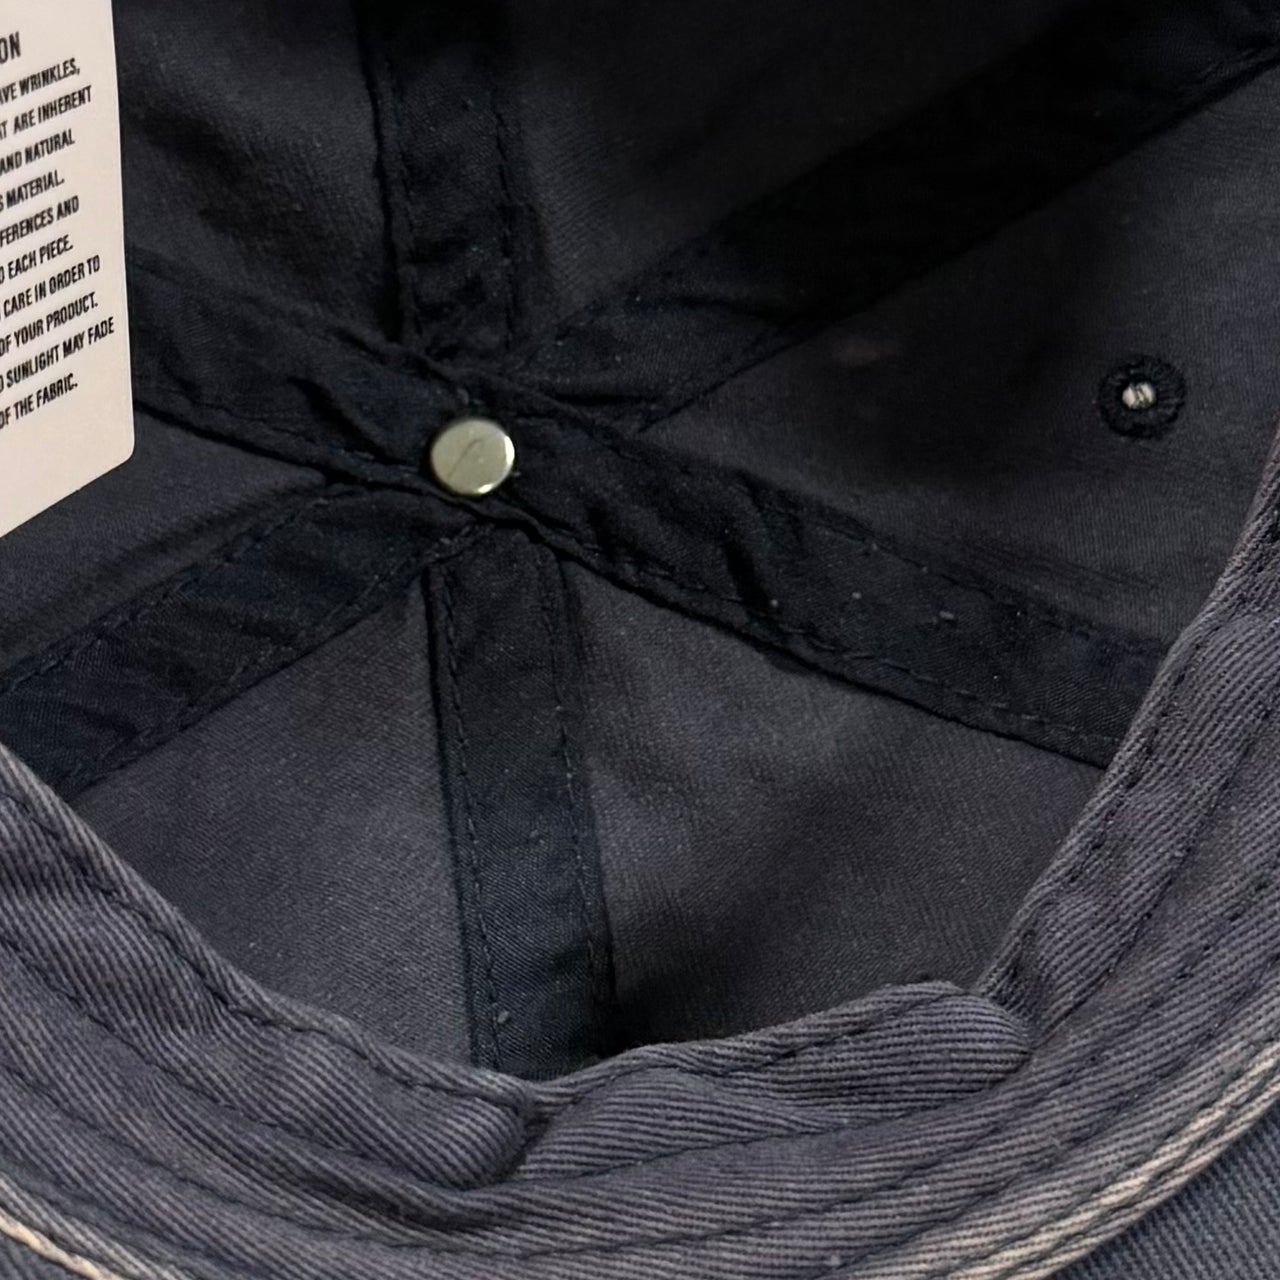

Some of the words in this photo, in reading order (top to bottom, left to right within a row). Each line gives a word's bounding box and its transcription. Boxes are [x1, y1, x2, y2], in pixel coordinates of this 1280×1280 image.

[19, 57, 80, 96] WRINKLES,
[14, 109, 36, 134] ARE
[38, 85, 91, 123] INHERENT
[0, 151, 22, 176] AND
[24, 128, 75, 164] NATURAL
[6, 170, 64, 208] MATERIAL.
[56, 195, 79, 220] AND
[7, 250, 37, 280] EACH
[39, 234, 73, 264] PIECE.
[3, 288, 32, 318] CARE
[34, 280, 46, 302] IN
[49, 262, 85, 294] ORDER
[86, 254, 100, 275] TO
[14, 319, 44, 347] YOUR
[46, 291, 98, 332] PRODUCT.
[6, 344, 59, 388] SUNLIGHT
[62, 331, 85, 358] MAY
[87, 316, 114, 345] FADE
[13, 394, 34, 420] THE
[36, 373, 78, 408] FABRIC.
